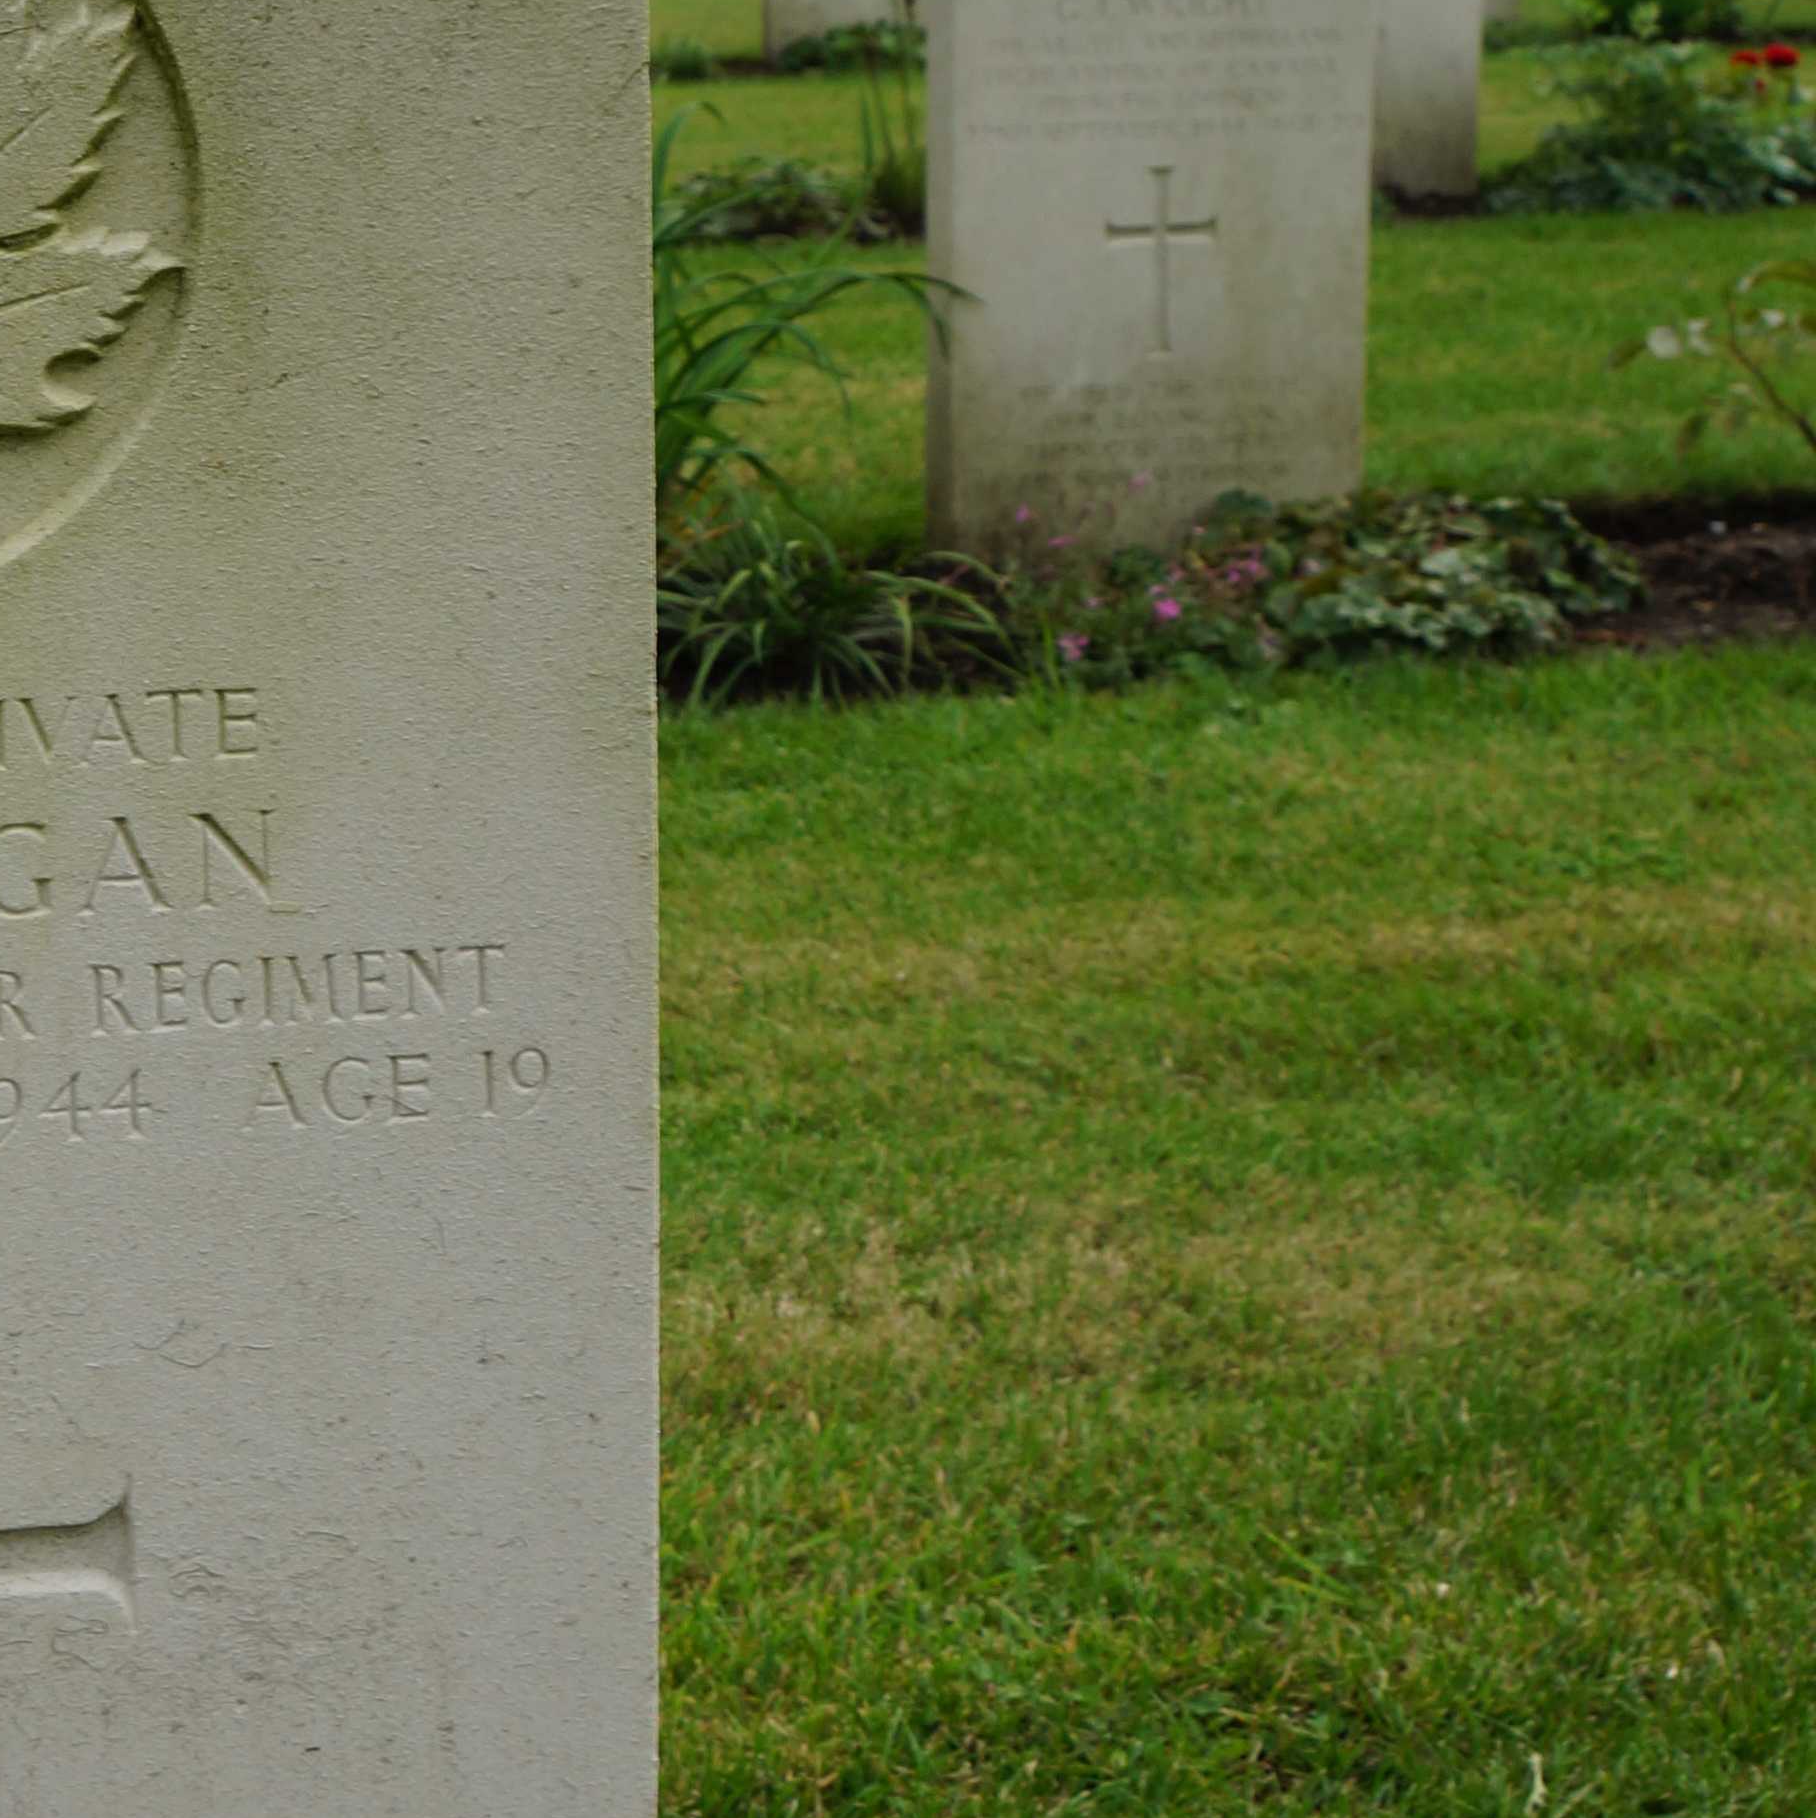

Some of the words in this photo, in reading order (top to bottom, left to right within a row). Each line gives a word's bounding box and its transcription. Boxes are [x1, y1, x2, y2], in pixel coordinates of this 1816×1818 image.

[87, 943, 507, 1037] REGIMENT
[240, 1052, 431, 1134] AGE
[478, 1046, 552, 1119] 19
